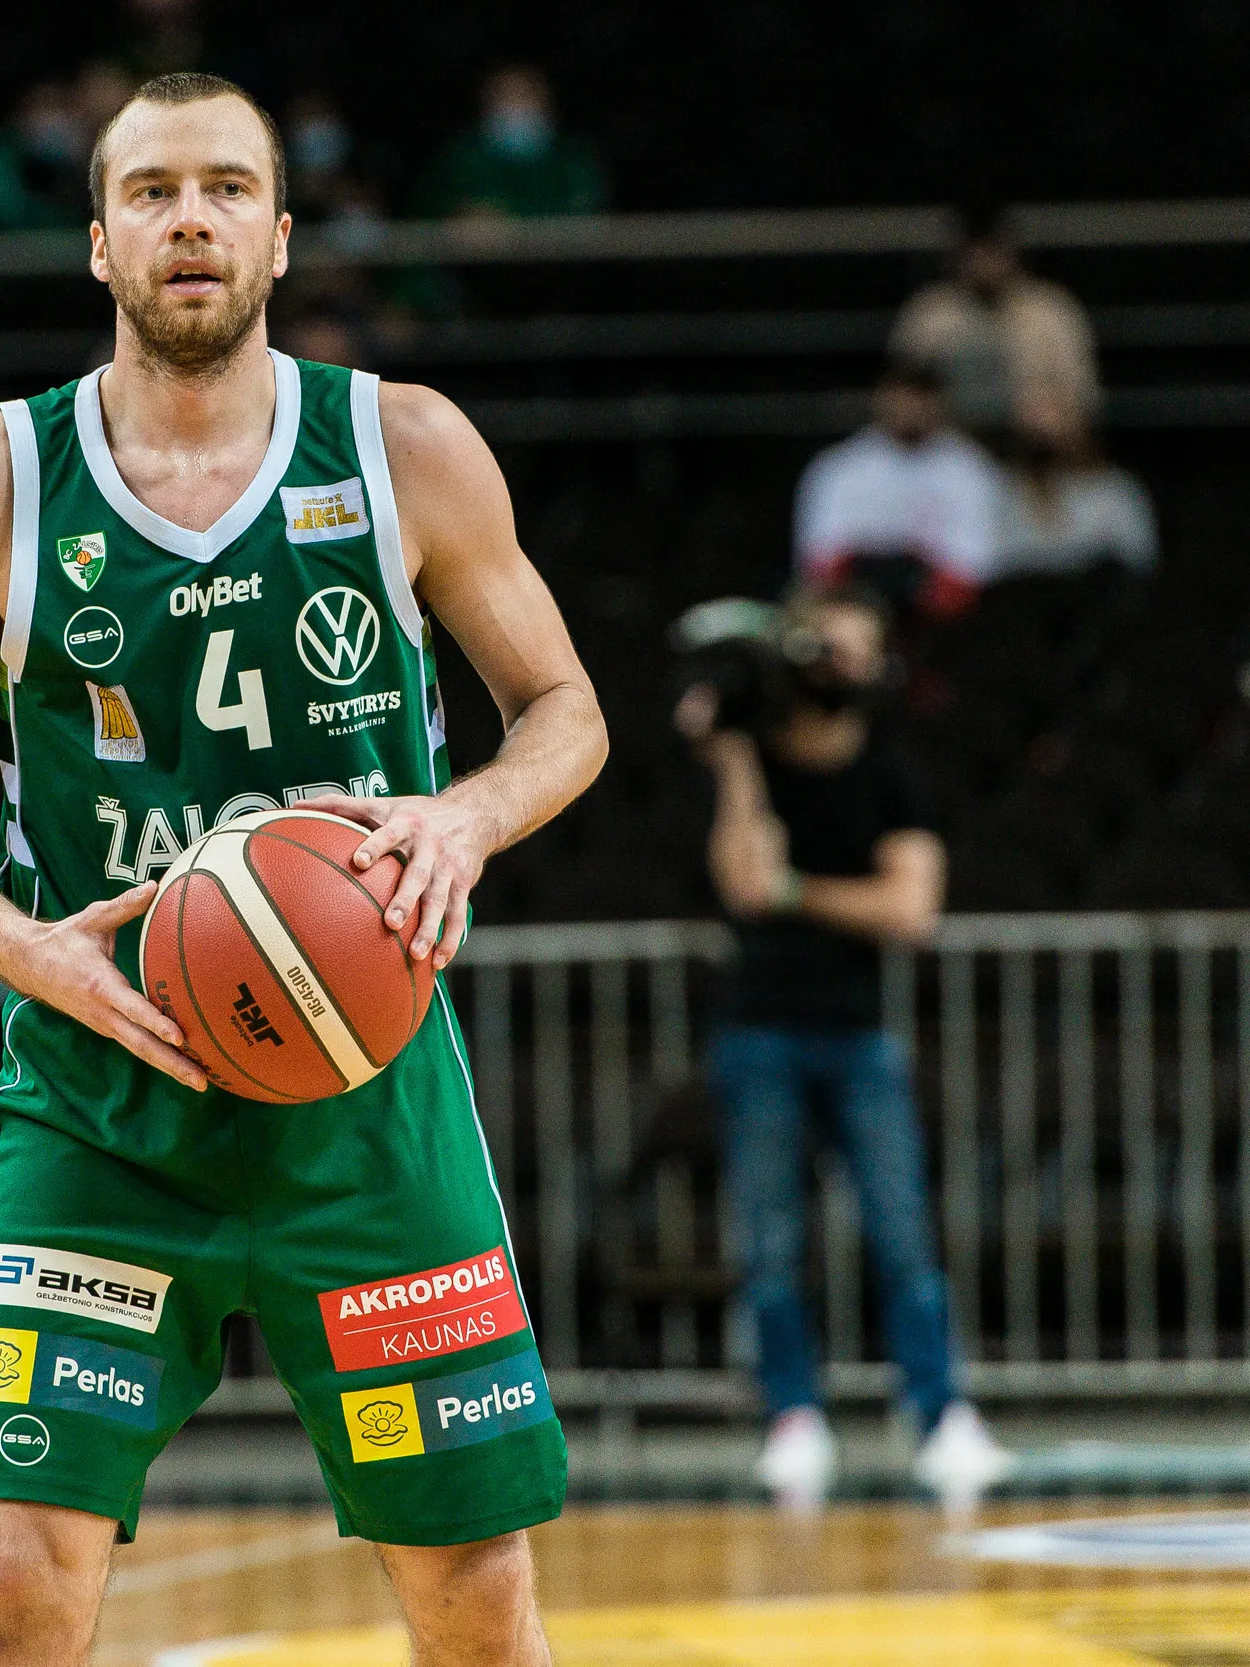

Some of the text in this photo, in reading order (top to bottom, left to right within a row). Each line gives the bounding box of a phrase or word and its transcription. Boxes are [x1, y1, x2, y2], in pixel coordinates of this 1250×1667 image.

[294, 503, 359, 530] JKL
[169, 572, 263, 618] OlyBet
[69, 627, 119, 645] GSA
[196, 629, 272, 750] 4
[307, 691, 401, 725] ŠVYTURYS
[232, 982, 285, 1047] JKL
[287, 965, 326, 1018] BG4500
[230, 1015, 254, 1047] betsafe
[36, 1292, 153, 1323] GELŽBETONIO KONSTRUKCIJOS
[38, 1269, 157, 1311] aksa
[339, 1255, 505, 1320] AKROPOLIS
[381, 1311, 497, 1359] KAUNAS
[52, 1356, 145, 1407] Perlas
[437, 1381, 536, 1430] Perlas
[2, 1433, 46, 1446] GSA
